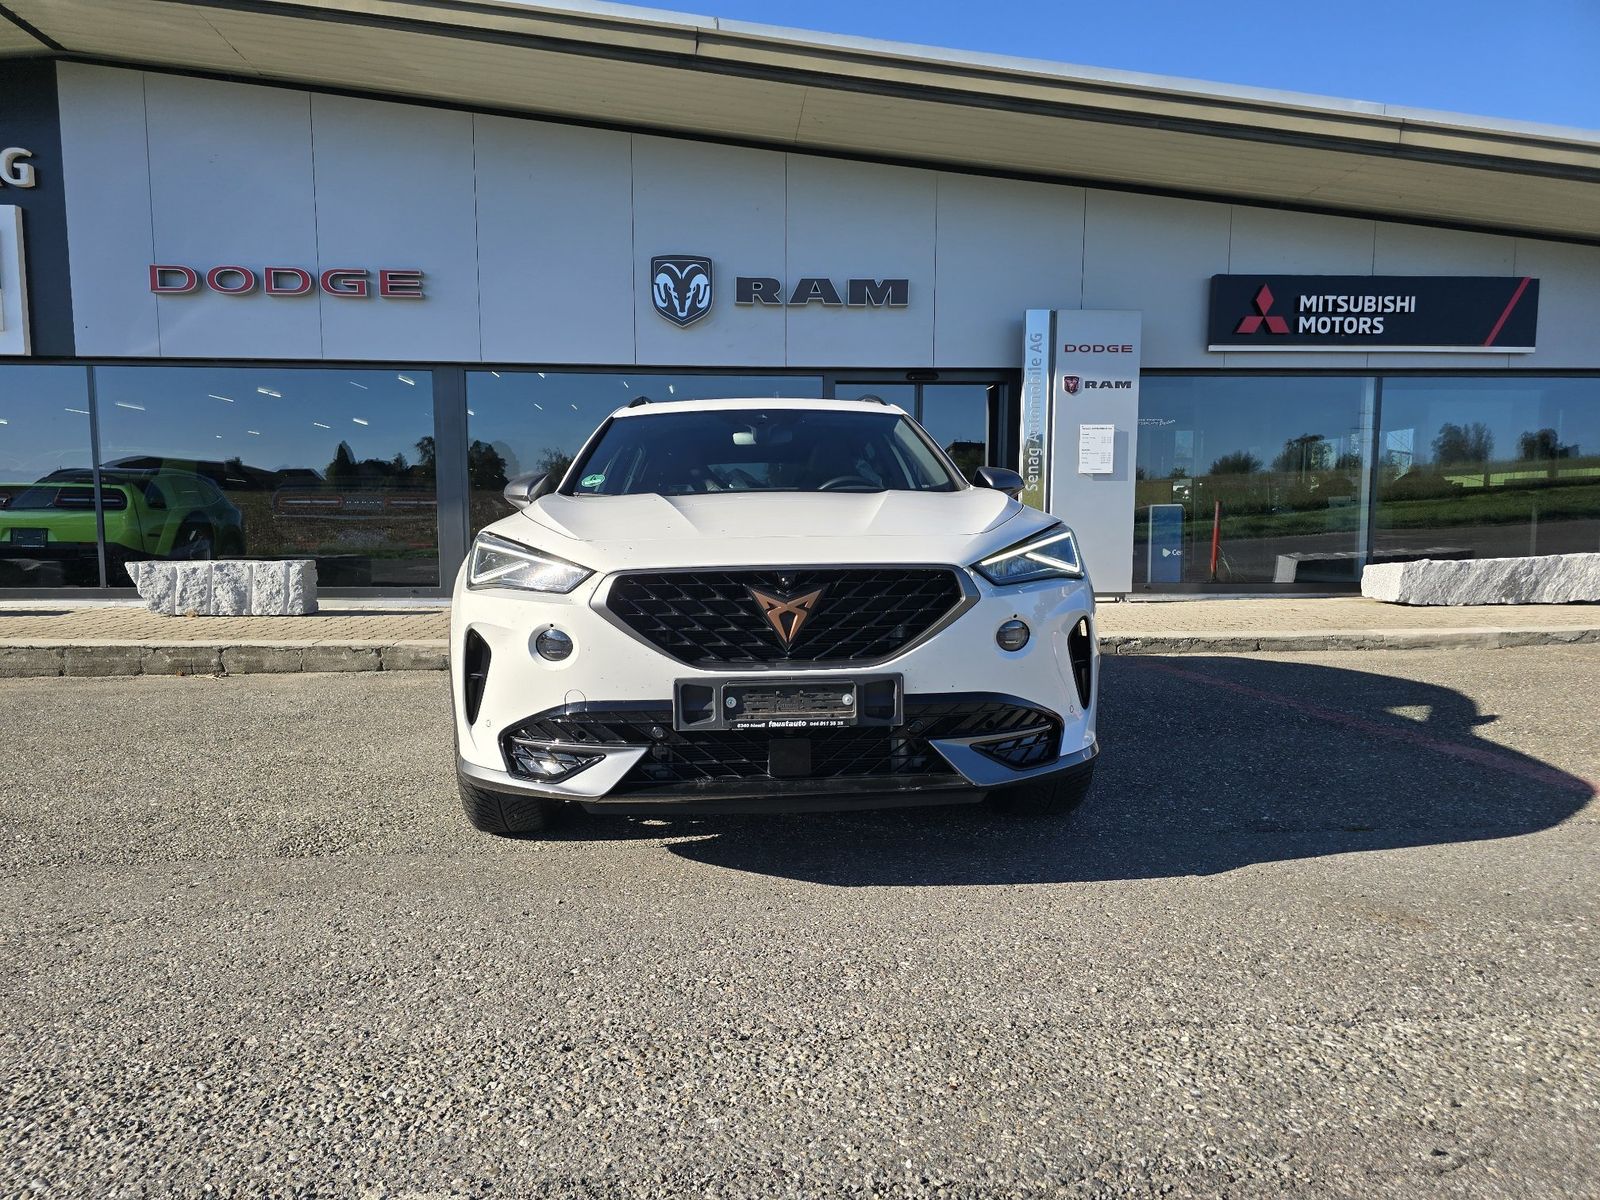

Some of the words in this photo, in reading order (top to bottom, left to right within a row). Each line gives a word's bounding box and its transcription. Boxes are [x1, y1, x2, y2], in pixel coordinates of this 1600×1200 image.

[0, 147, 36, 187] G
[149, 264, 424, 298] DODGE
[734, 276, 910, 306] RAM
[1299, 295, 1417, 314] MITSUBISHI
[1298, 316, 1385, 335] MOTORS
[1029, 332, 1043, 354] AG
[1064, 344, 1133, 353] DODGE
[1084, 380, 1132, 389] RAM
[1027, 357, 1042, 443] Automobile
[1025, 448, 1042, 491] Senag
[768, 720, 807, 728] faustauto
